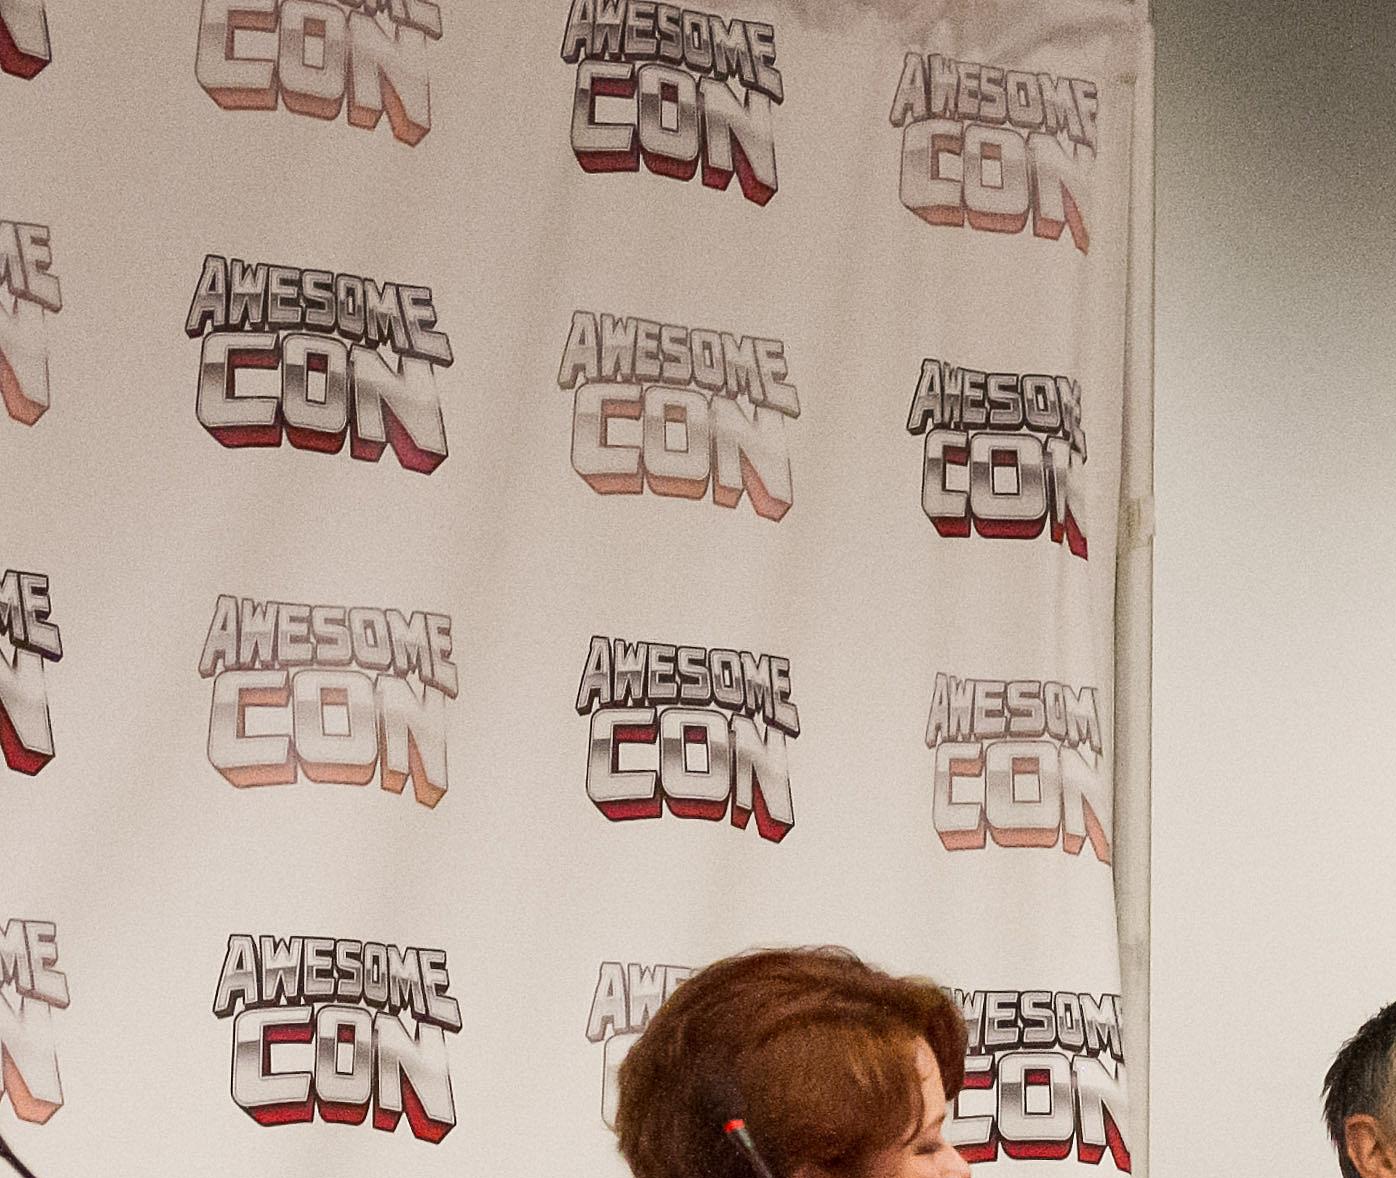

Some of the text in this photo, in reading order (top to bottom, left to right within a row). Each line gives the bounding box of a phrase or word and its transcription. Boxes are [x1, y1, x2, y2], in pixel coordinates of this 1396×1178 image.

[195, 0, 431, 147] CON
[561, 0, 784, 105] AWESOME
[889, 52, 1097, 160] AWESOME
[571, 58, 778, 207] CON
[899, 118, 1090, 256] CON
[185, 254, 454, 368] AWESOME
[557, 310, 800, 418] AWESOME
[196, 331, 449, 476] CON
[571, 382, 793, 523] CON
[906, 358, 1088, 466] AWESOM
[921, 428, 1088, 562] CON
[198, 594, 458, 699] AWESOME
[575, 635, 800, 738] AWESOME
[207, 669, 449, 809] CON
[586, 706, 795, 844] CON
[925, 672, 1103, 757] AWESOM
[932, 740, 1112, 867] CON
[212, 934, 462, 1033] AWESOME
[940, 986, 1125, 1064] WESOM
[230, 1004, 457, 1144] CON
[949, 1051, 1132, 1175] CON
